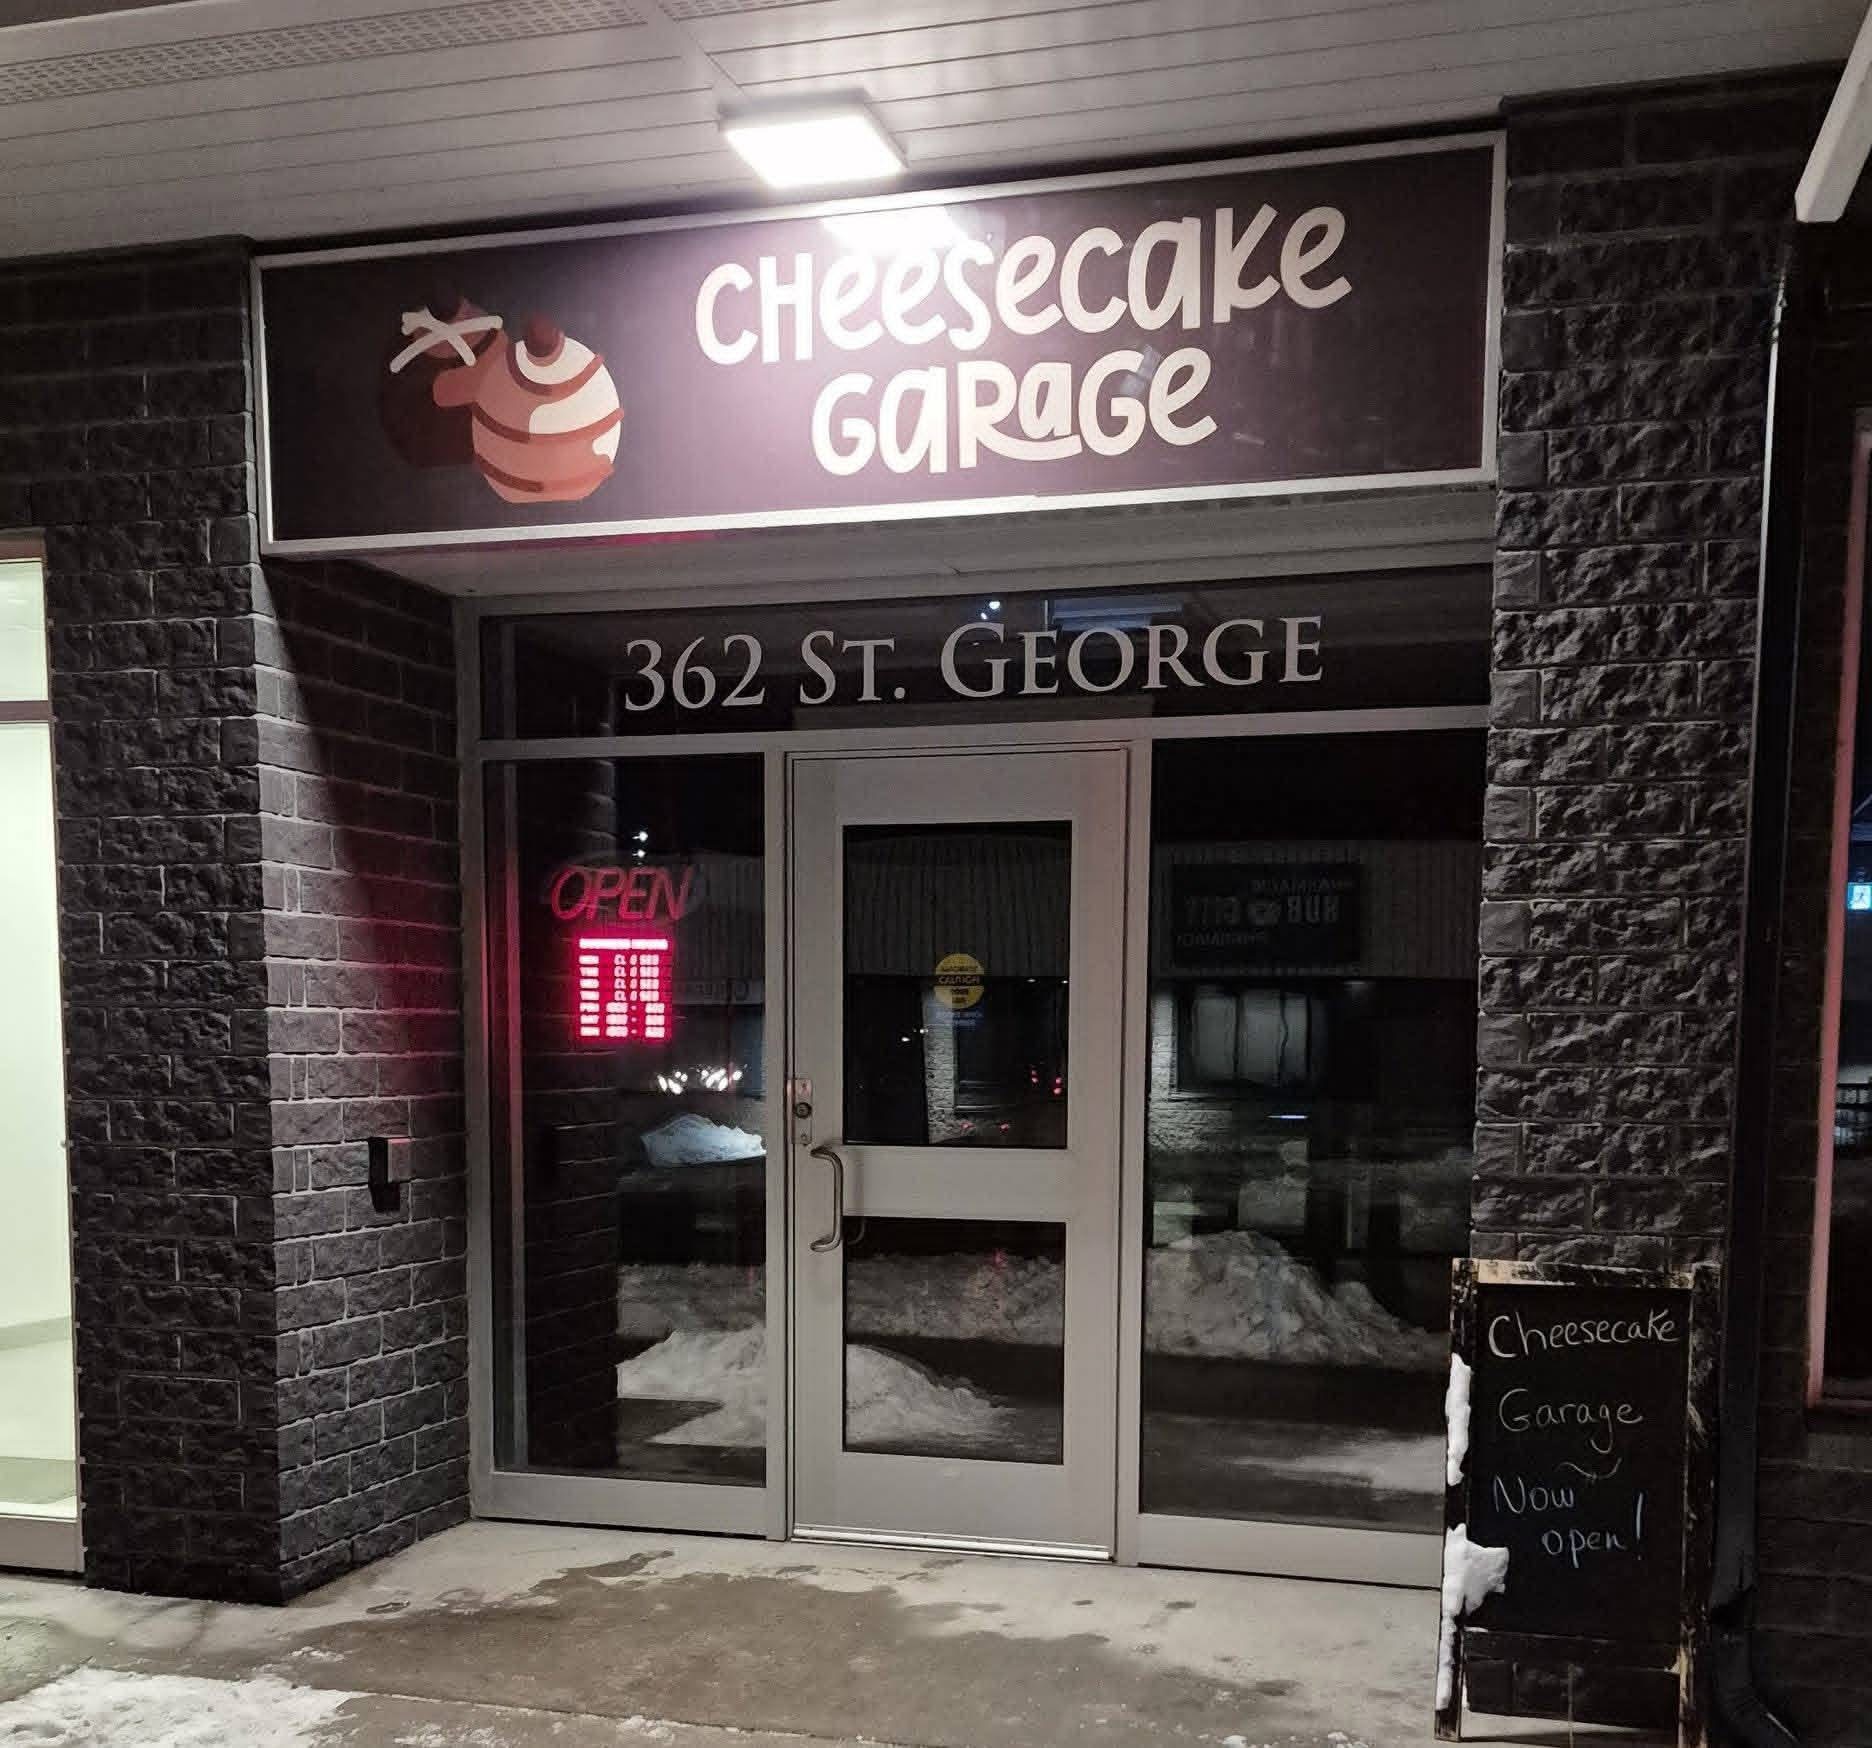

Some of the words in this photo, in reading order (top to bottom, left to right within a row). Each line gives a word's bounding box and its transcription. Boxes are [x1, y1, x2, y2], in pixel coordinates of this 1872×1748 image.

[624, 633, 767, 712] 362
[798, 629, 907, 705] ST.
[939, 615, 1324, 699] GEORGE
[551, 867, 693, 920] OPEN
[1488, 1308, 1681, 1358] Cheesecake
[1499, 1388, 1643, 1454] Garage
[1493, 1474, 1575, 1515] Now
